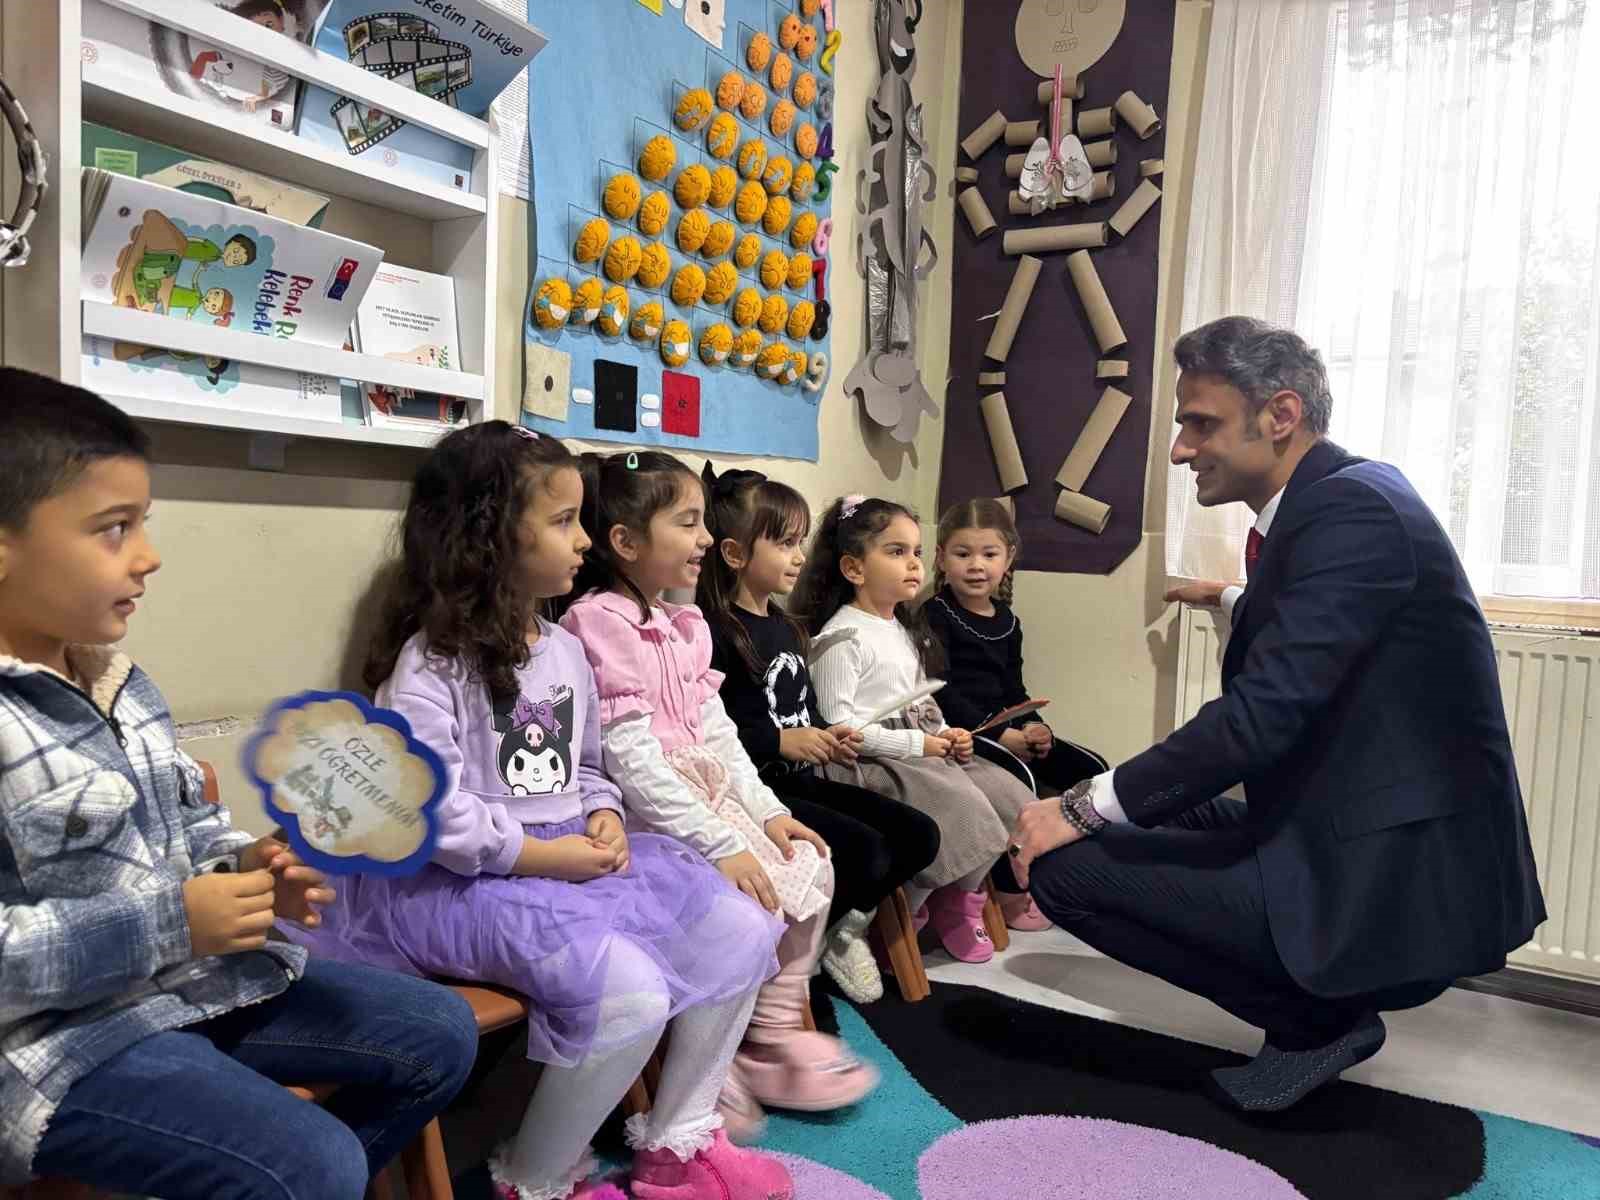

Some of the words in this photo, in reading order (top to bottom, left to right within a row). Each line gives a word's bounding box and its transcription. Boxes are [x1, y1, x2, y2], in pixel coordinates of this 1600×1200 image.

[471, 19, 524, 57] Türkiye
[820, 29, 842, 76] 2
[816, 122, 835, 157] 4
[812, 158, 840, 202] 5
[813, 217, 833, 257] 6
[282, 274, 314, 318] Renk
[811, 258, 827, 301] 7
[810, 299, 831, 341] 8
